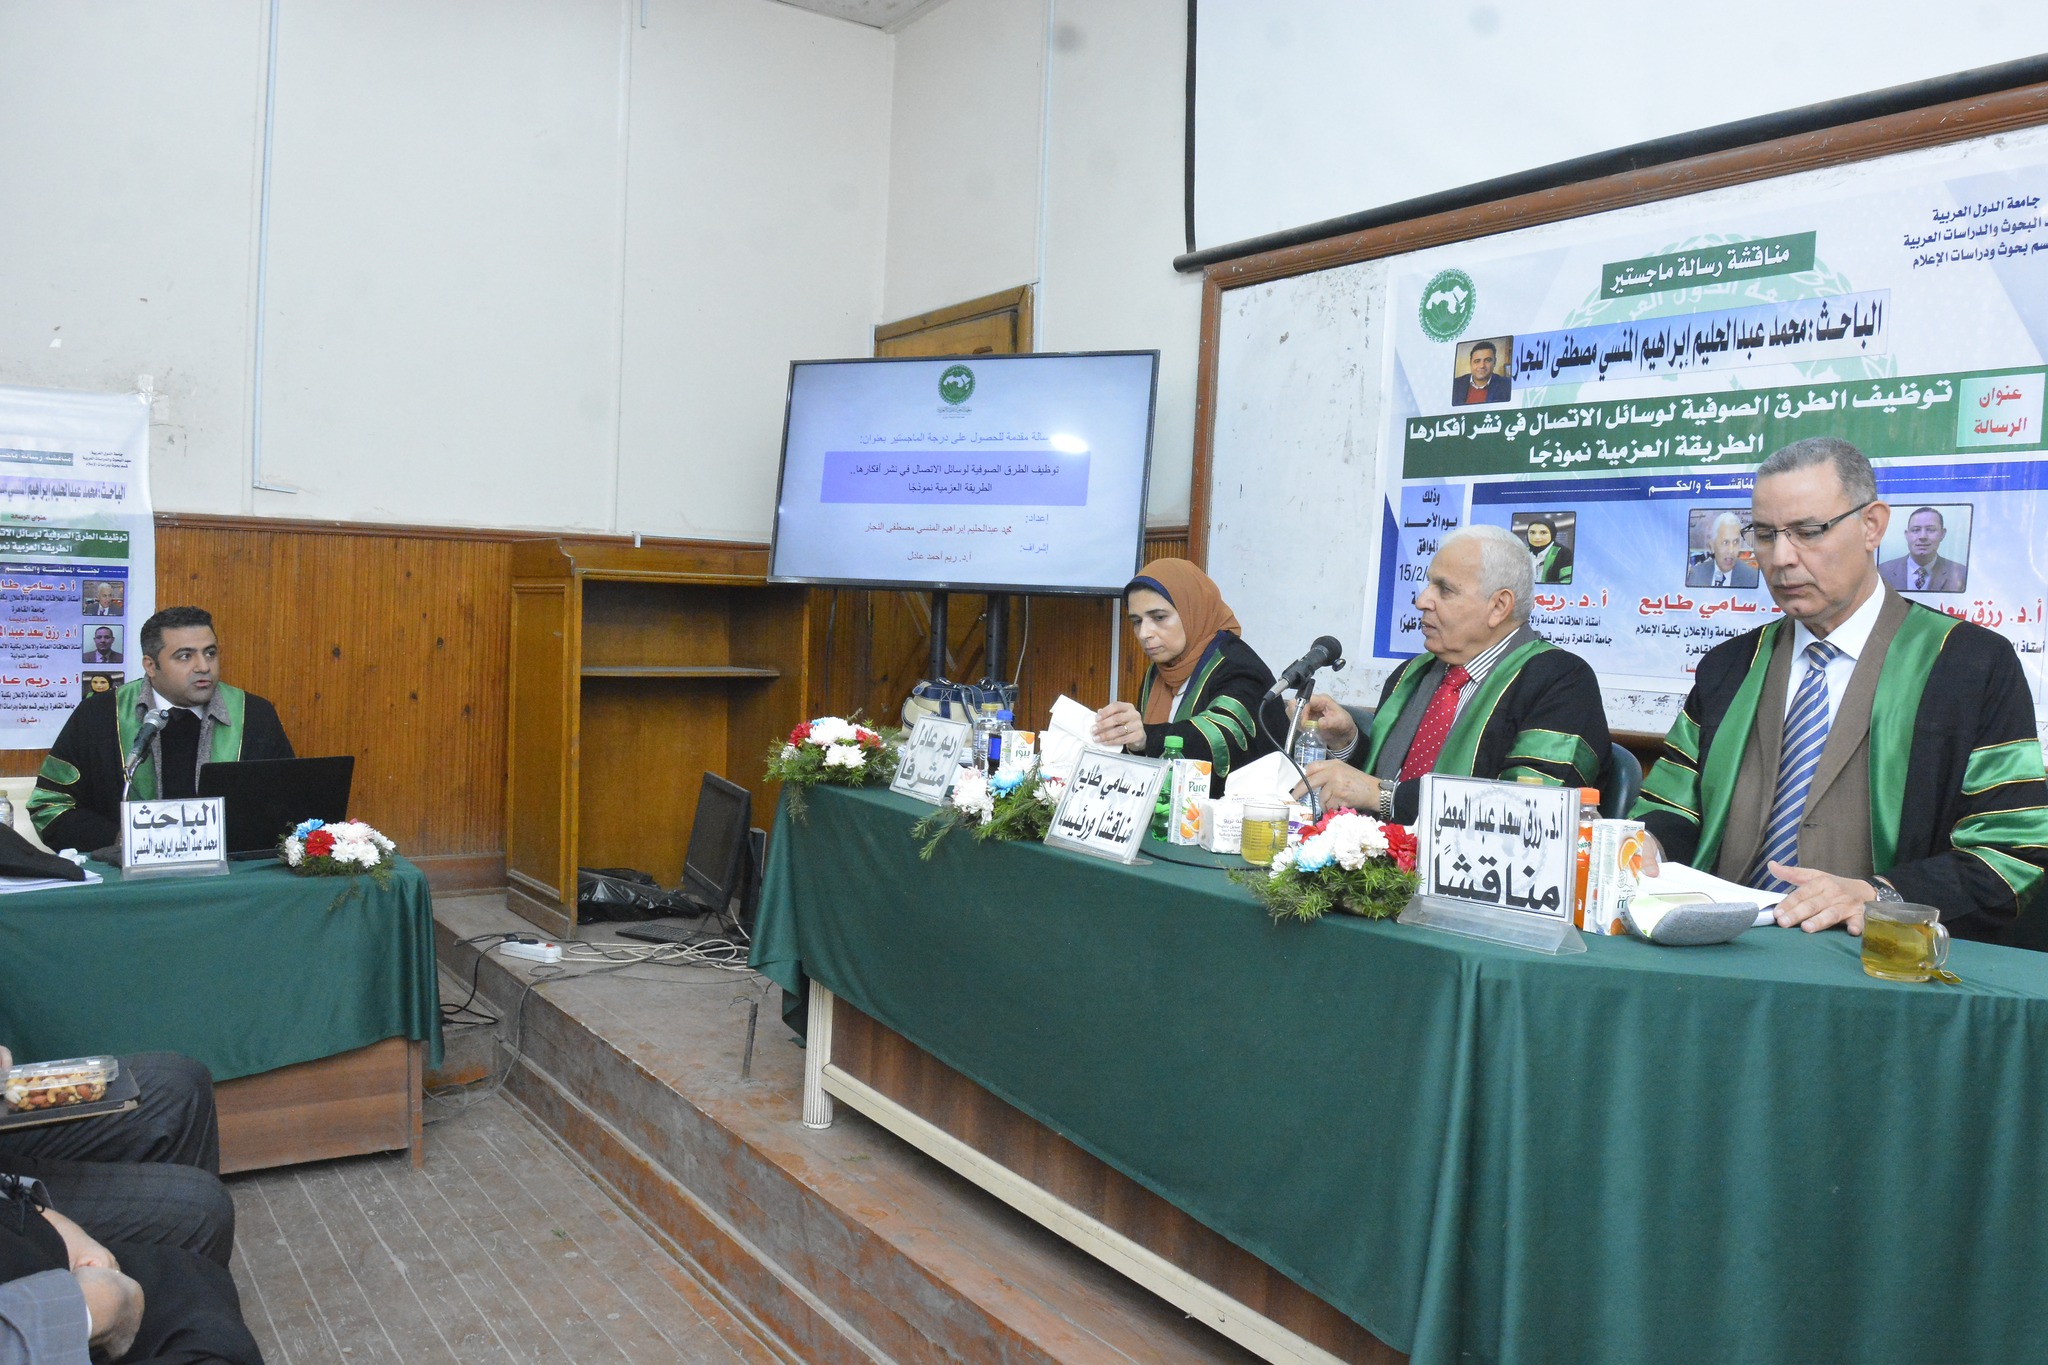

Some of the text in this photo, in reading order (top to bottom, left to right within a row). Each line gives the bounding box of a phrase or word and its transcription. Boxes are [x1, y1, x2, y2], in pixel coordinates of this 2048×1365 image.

[1933, 195, 2040, 224] جامعة الدول العربية
[1944, 224, 1998, 241] والدراسات
[2000, 217, 2041, 234] البحوث
[1904, 232, 1941, 249] العربية
[1913, 242, 2048, 269] سم بحوث ودراسات الإعلام
[1610, 244, 1790, 294] مناقشة رسالة ماجستير
[1599, 327, 1638, 381] المنسي
[1640, 323, 1691, 371] إبراهيم
[1512, 339, 1550, 381] النجار
[1551, 334, 1597, 378] مصطفى
[1979, 385, 2022, 408] عنوان
[1410, 379, 1953, 442] توظيف الطرق الصوفية لوسائل الاتصال في نشر أفكارها
[1974, 417, 2027, 438] الرسالة
[890, 433, 924, 444] الماجستير
[927, 434, 948, 444] درجة
[1006, 433, 1029, 443] مقدمة
[1597, 438, 1669, 466] العزمية
[1675, 433, 1764, 462] الطريقة
[883, 465, 897, 476] نشر
[899, 465, 910, 476] في
[912, 465, 941, 474] الاتصال
[943, 465, 969, 475] لوسائل
[971, 465, 1001, 475] الصوفية
[1004, 465, 1028, 476] الطرق
[1031, 465, 1059, 474] توظيف
[935, 483, 962, 493] العزمية
[964, 483, 992, 494] الطريقة
[1705, 478, 1754, 490] لمناقشة
[1423, 488, 1440, 506] وذلك
[16, 529, 128, 543] توظيف الطرق الصوفية لوسائل
[12, 542, 40, 552] العزمية
[42, 543, 72, 554] الطريقة
[22, 582, 52, 593] سامي
[1639, 594, 1757, 618] سامي طايع
[1972, 600, 2002, 628] رزق
[1541, 615, 1600, 626] أستاذ العلاقات العامة
[1572, 634, 1594, 645] القاهرة
[1595, 634, 1612, 646] جامعة
[25, 677, 50, 687] ريم
[910, 723, 938, 751] عادل
[936, 736, 957, 758] ريم
[1072, 763, 1131, 800] سامي طايع
[1188, 781, 1207, 792] Pure
[133, 802, 216, 835] الباحث
[1435, 790, 1471, 845] المعطي
[1475, 800, 1495, 845] عبد
[1500, 803, 1521, 835] سعد
[1523, 799, 1542, 849] رزق
[204, 837, 217, 850] محمد
